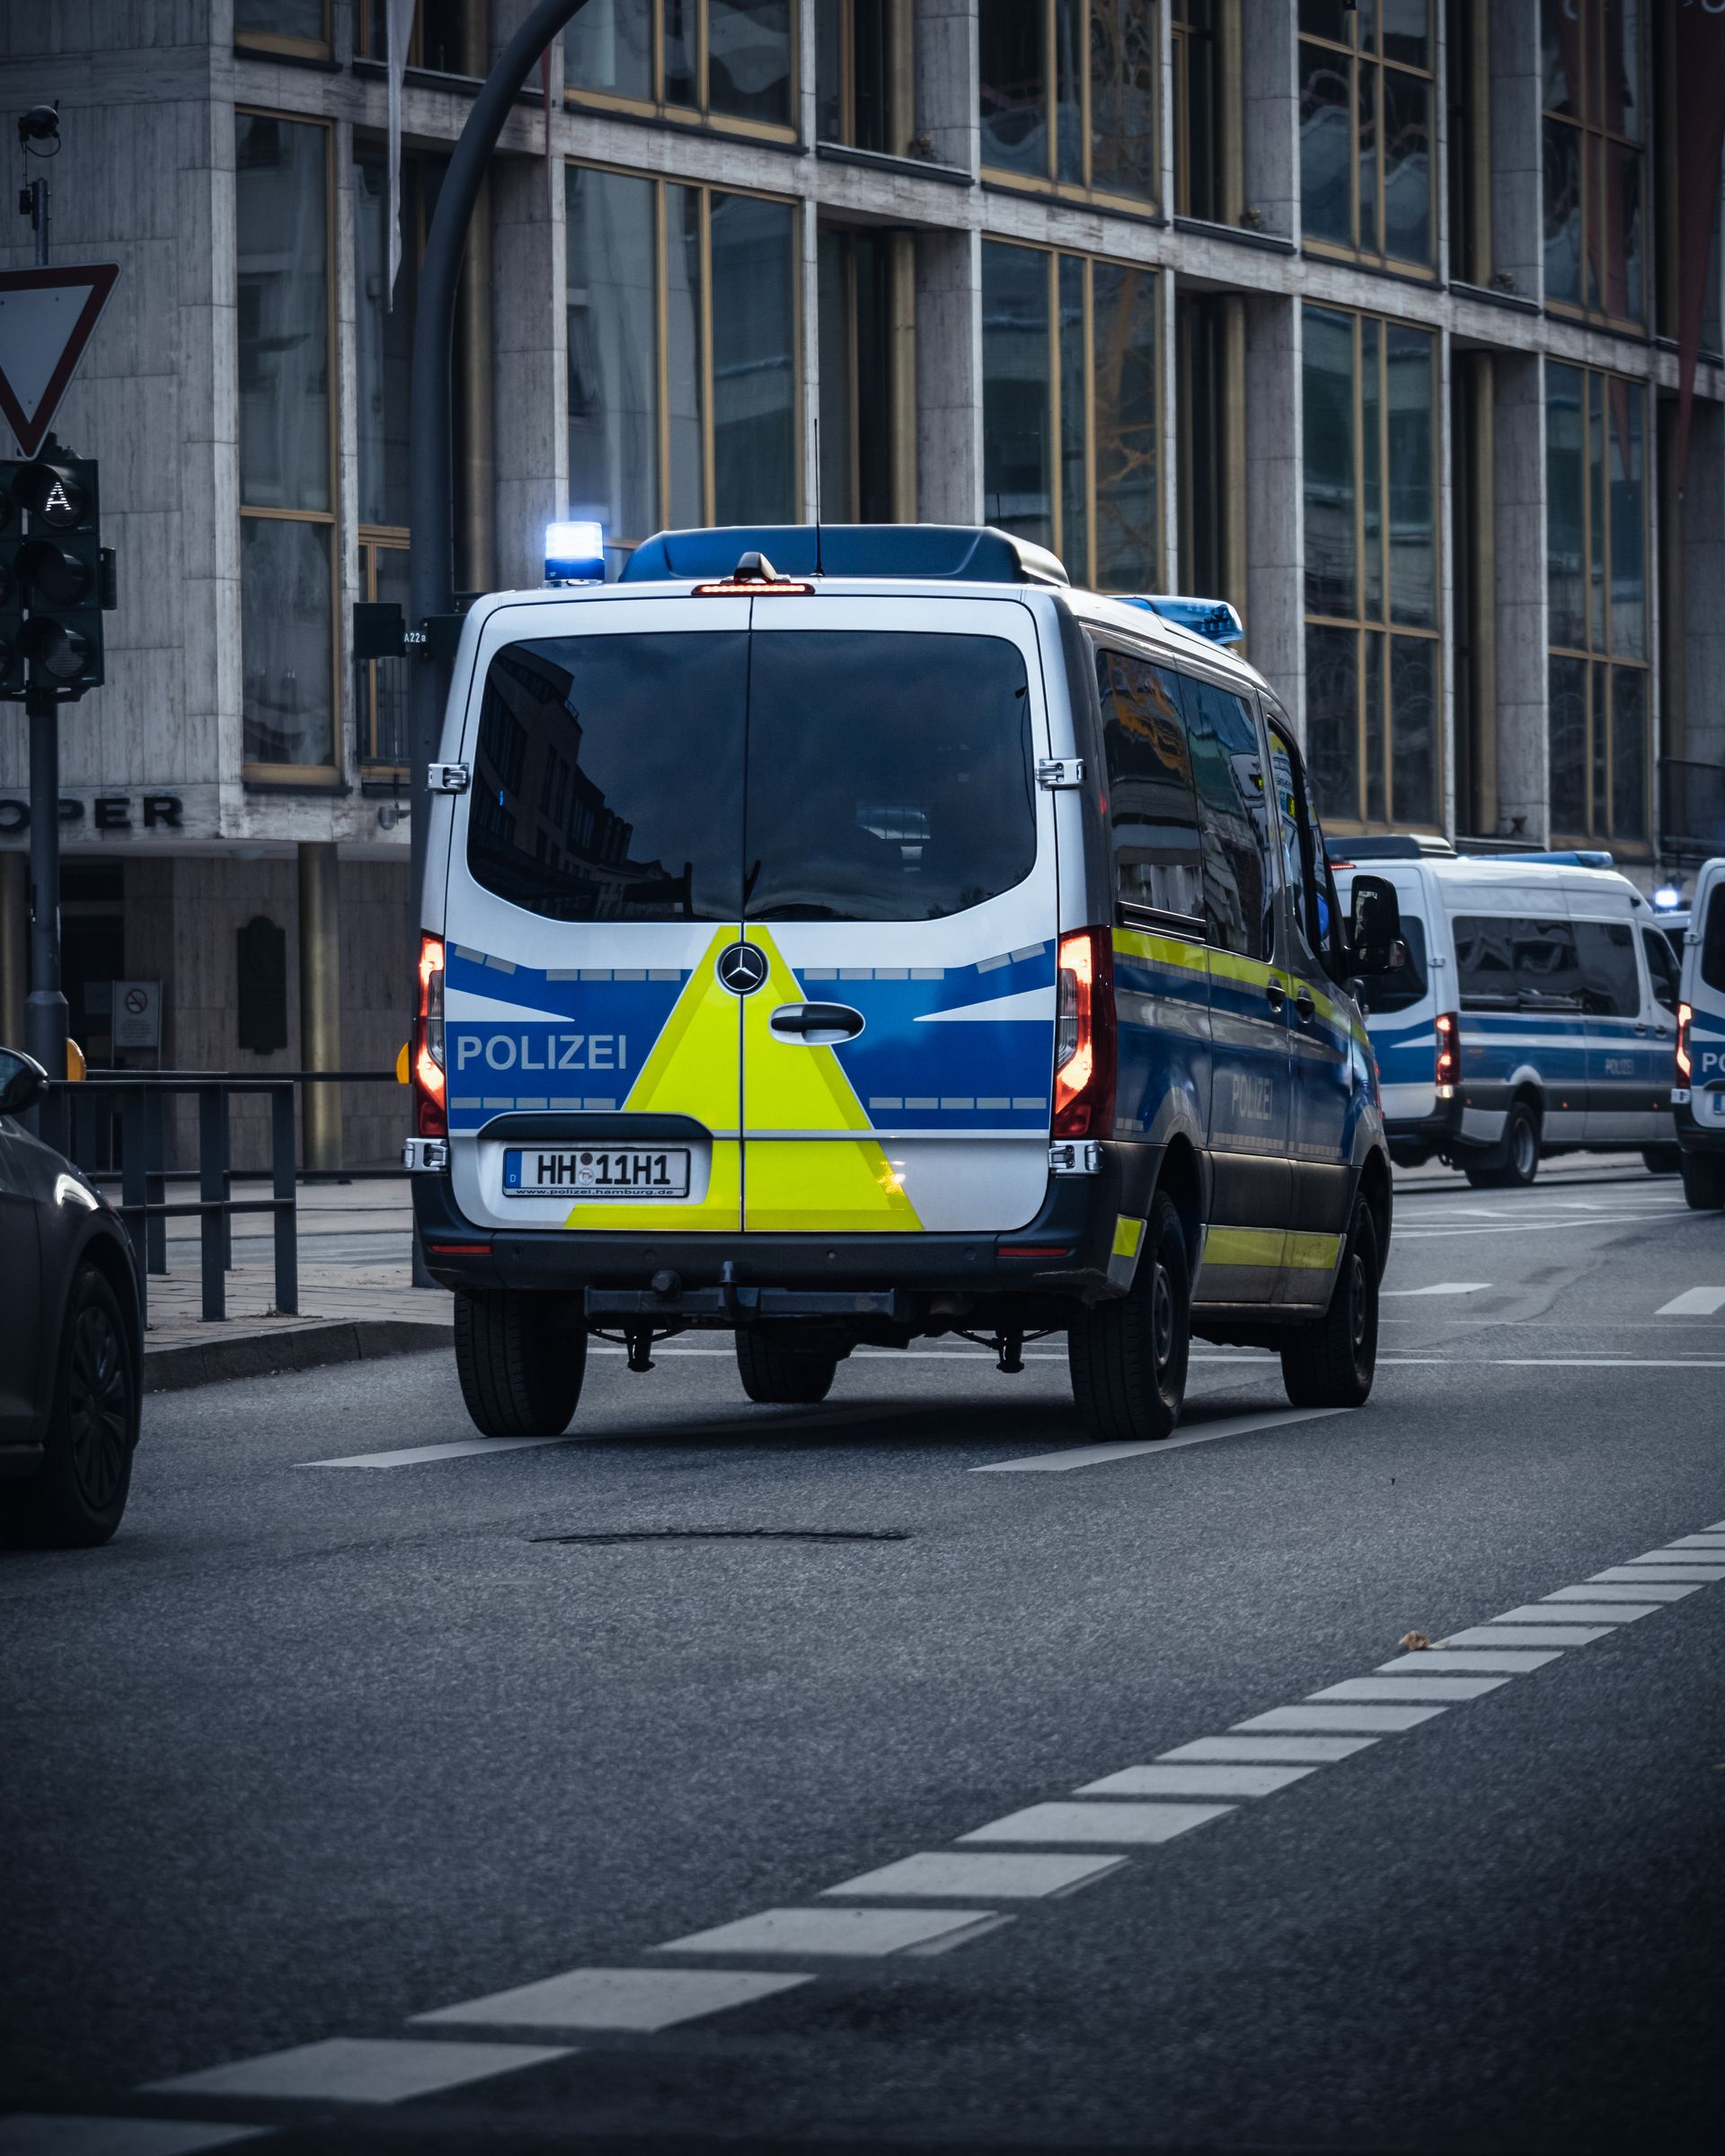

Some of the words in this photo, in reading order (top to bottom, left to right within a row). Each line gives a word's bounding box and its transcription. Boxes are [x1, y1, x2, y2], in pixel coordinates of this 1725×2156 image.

[46, 482, 72, 511] A
[404, 632, 427, 643] A22a
[457, 1035, 626, 1070] POLIZEI
[1232, 1074, 1273, 1121] POLIZEI
